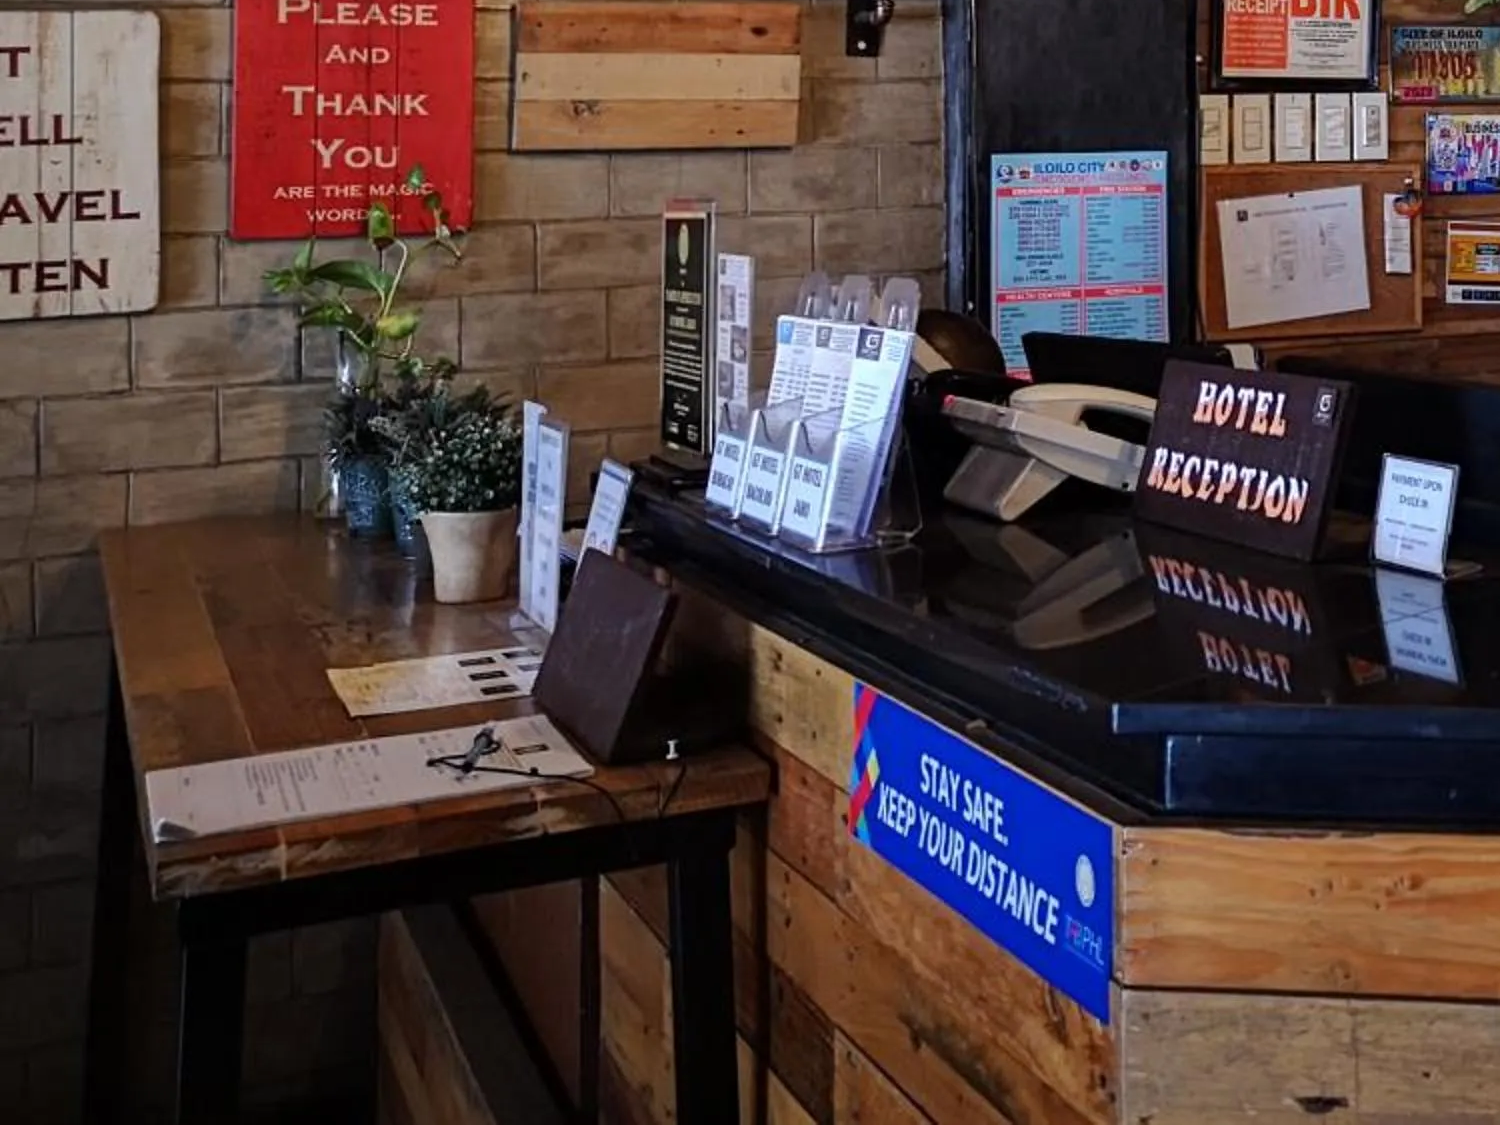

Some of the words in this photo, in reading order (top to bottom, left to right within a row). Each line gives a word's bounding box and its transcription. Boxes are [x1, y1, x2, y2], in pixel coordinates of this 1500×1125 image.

[325, 43, 391, 64] AND
[282, 85, 429, 116] THANK
[311, 138, 398, 169] YOU
[1078, 162, 1104, 173] CITY
[273, 186, 315, 200] ARE
[321, 185, 364, 198] THE
[1193, 381, 1287, 438] HOTEL
[1147, 445, 1309, 524] RECEPTION
[920, 753, 960, 812] STAY
[963, 779, 1009, 847] SAFE.
[877, 781, 917, 838] KEEP
[918, 805, 965, 877] YOUR
[965, 841, 1060, 945] DISTANCE
